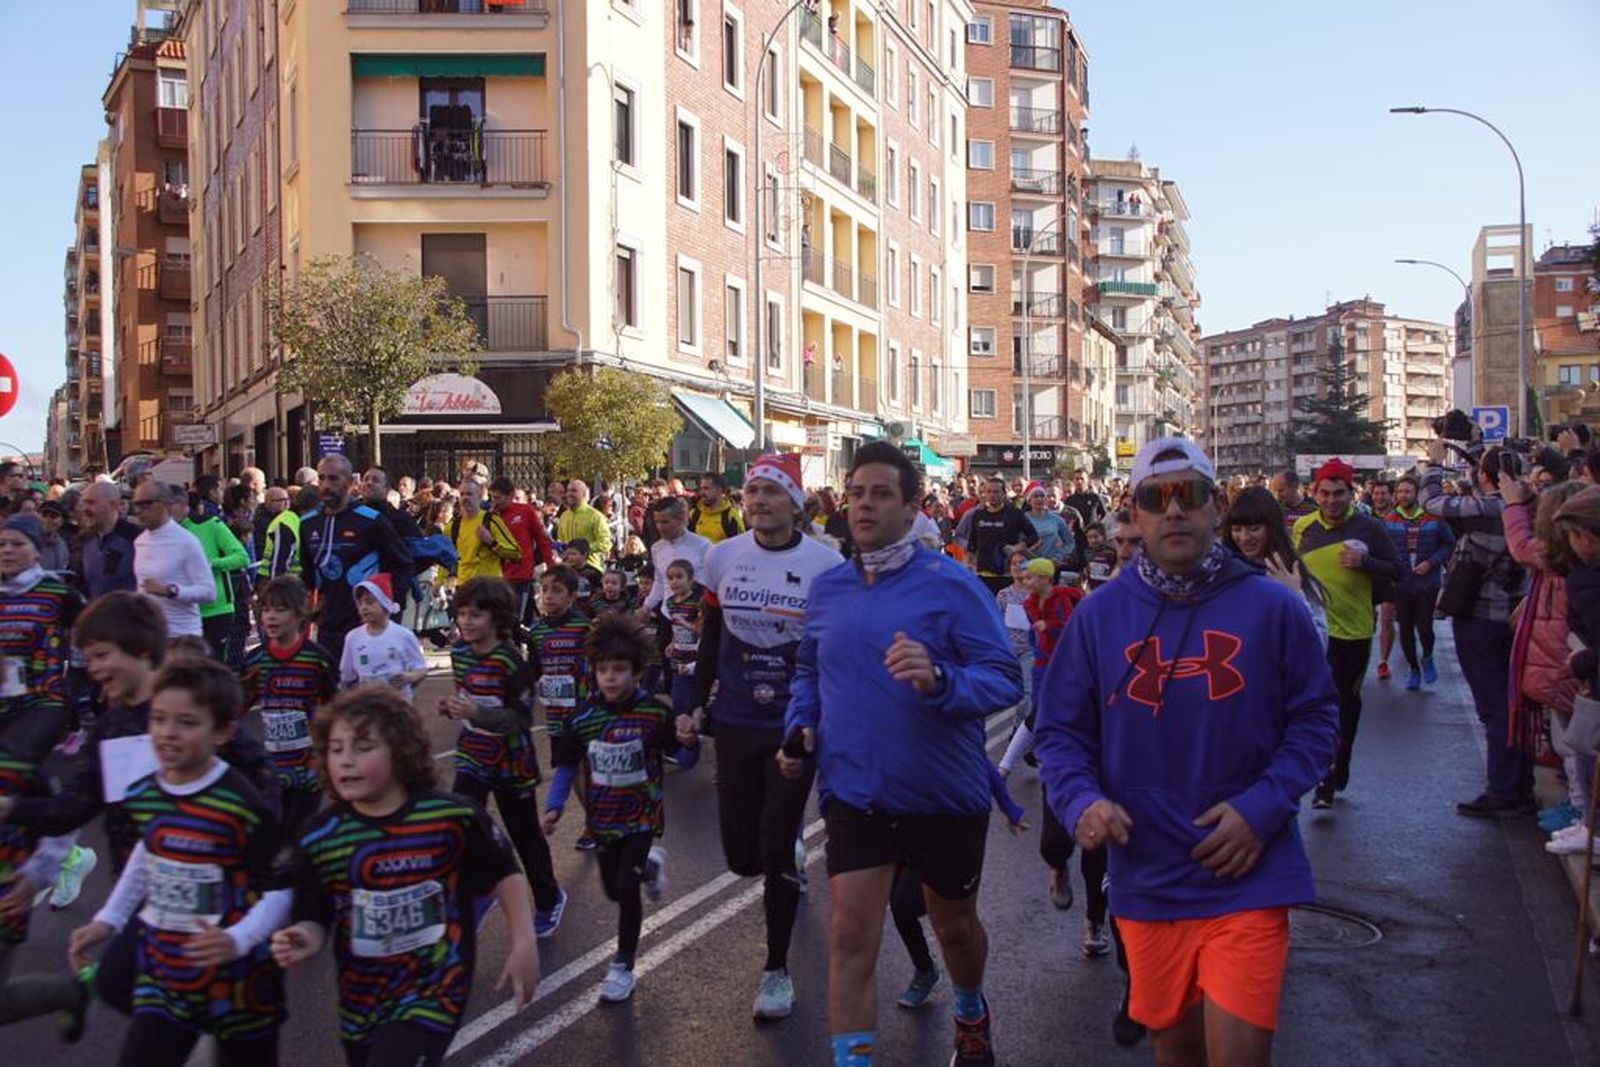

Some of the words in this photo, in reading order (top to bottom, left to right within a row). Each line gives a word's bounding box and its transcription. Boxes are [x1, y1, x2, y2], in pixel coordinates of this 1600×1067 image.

[1478, 411, 1501, 434] P
[724, 586, 808, 610] Movijerez
[363, 901, 425, 936] 6346
